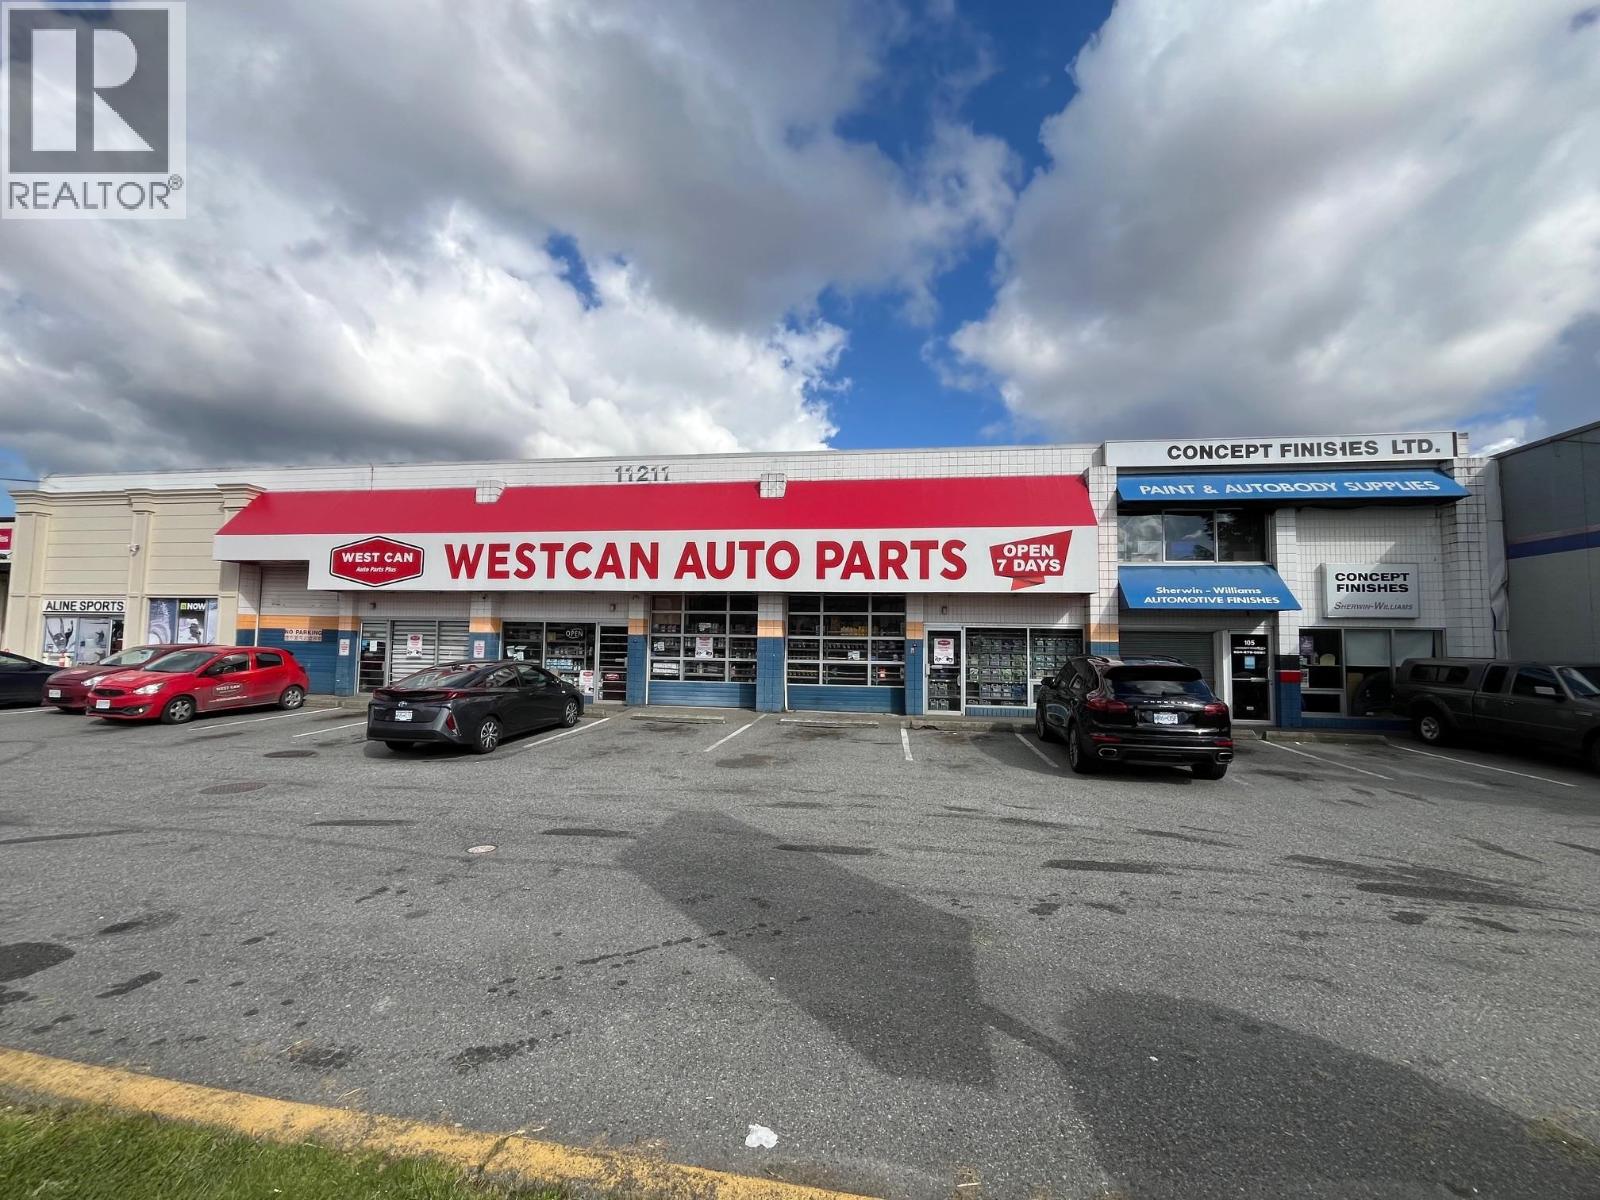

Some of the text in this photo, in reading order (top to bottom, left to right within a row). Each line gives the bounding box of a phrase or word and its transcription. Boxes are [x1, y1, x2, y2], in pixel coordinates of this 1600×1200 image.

[1168, 444, 1273, 460] CONCEPT
[1391, 438, 1441, 454] LTD.
[613, 465, 671, 482] 11211
[1139, 480, 1440, 496] PAINT & AUTOBODY SUPPLIES
[1002, 543, 1055, 558] OPEN
[341, 552, 414, 563] WEST CAN
[444, 539, 968, 581] WESTCAN AUTO PARTS
[996, 558, 1062, 573] 7 DAYS
[1334, 572, 1410, 582] CONCEPT
[1155, 585, 1204, 595] Sherwin
[1213, 585, 1262, 595] Williams
[1336, 583, 1409, 593] FINISHES
[45, 599, 125, 612] ALINE SPORTS
[186, 602, 207, 610] NOW
[1143, 595, 1280, 605] AUTOMOTIVE FINISHES
[565, 629, 584, 638] OPEN
